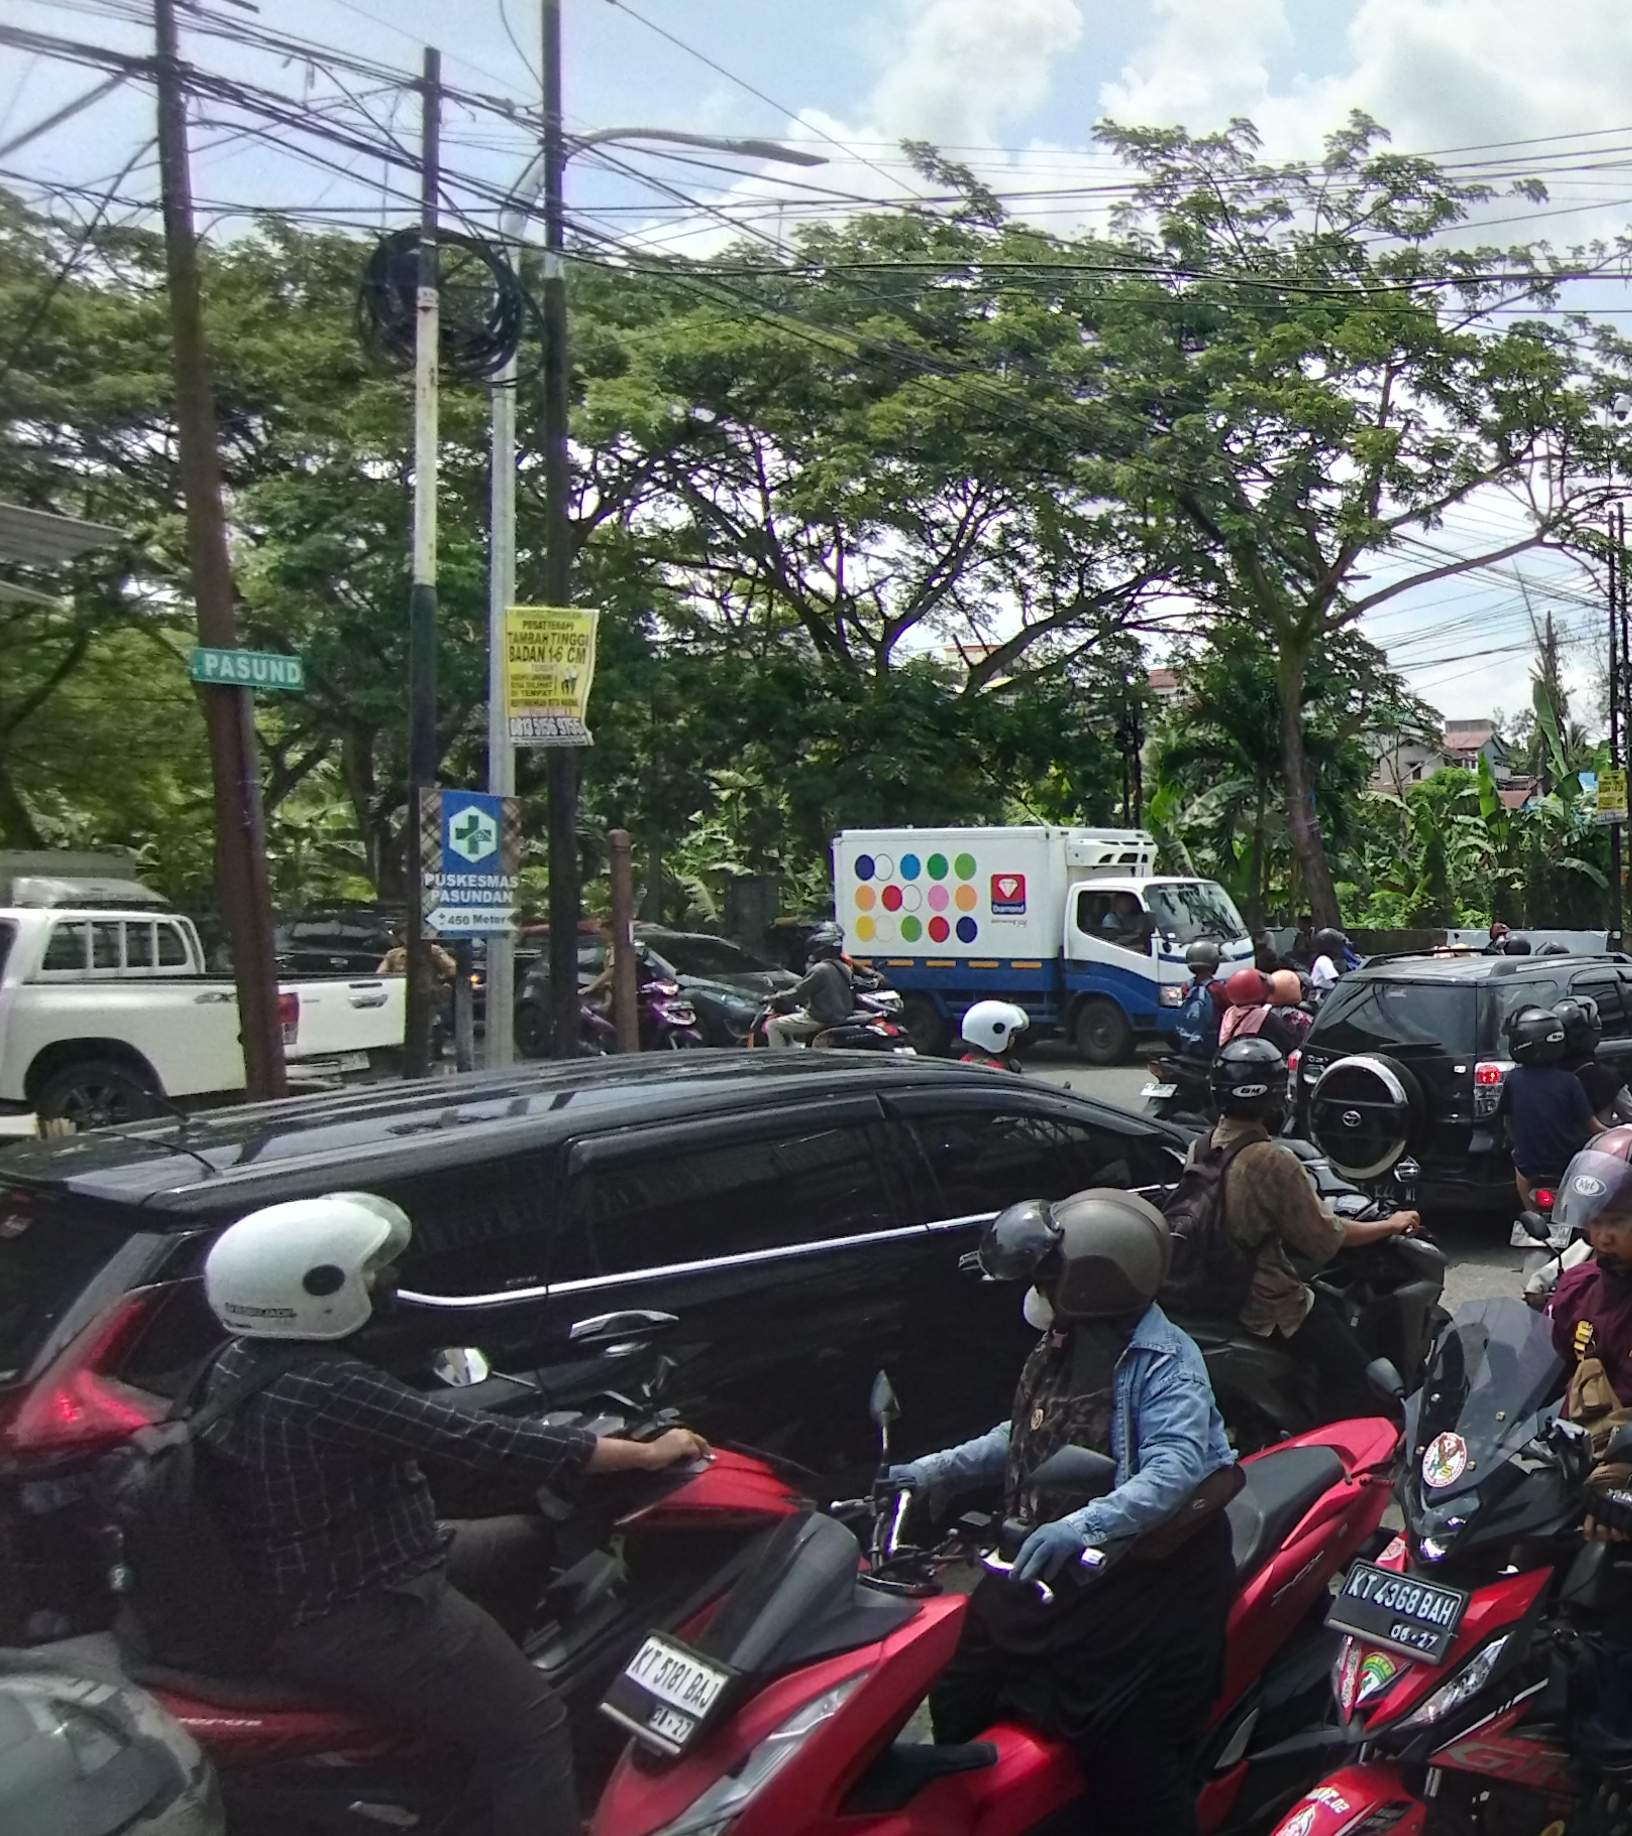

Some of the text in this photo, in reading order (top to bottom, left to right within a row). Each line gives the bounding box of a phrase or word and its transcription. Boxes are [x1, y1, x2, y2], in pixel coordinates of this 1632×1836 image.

[507, 631, 589, 647] TAMBAH TINGGI
[509, 645, 545, 662] BADAN
[567, 647, 586, 664] CM
[424, 871, 519, 888] PUSKESMAS
[431, 889, 513, 903] PASUNDAN
[447, 916, 470, 926] 450
[472, 914, 506, 925] Meter
[1348, 1570, 1456, 1626] KT 4368 BAH
[631, 1645, 719, 1709] KT 5181 BAJ
